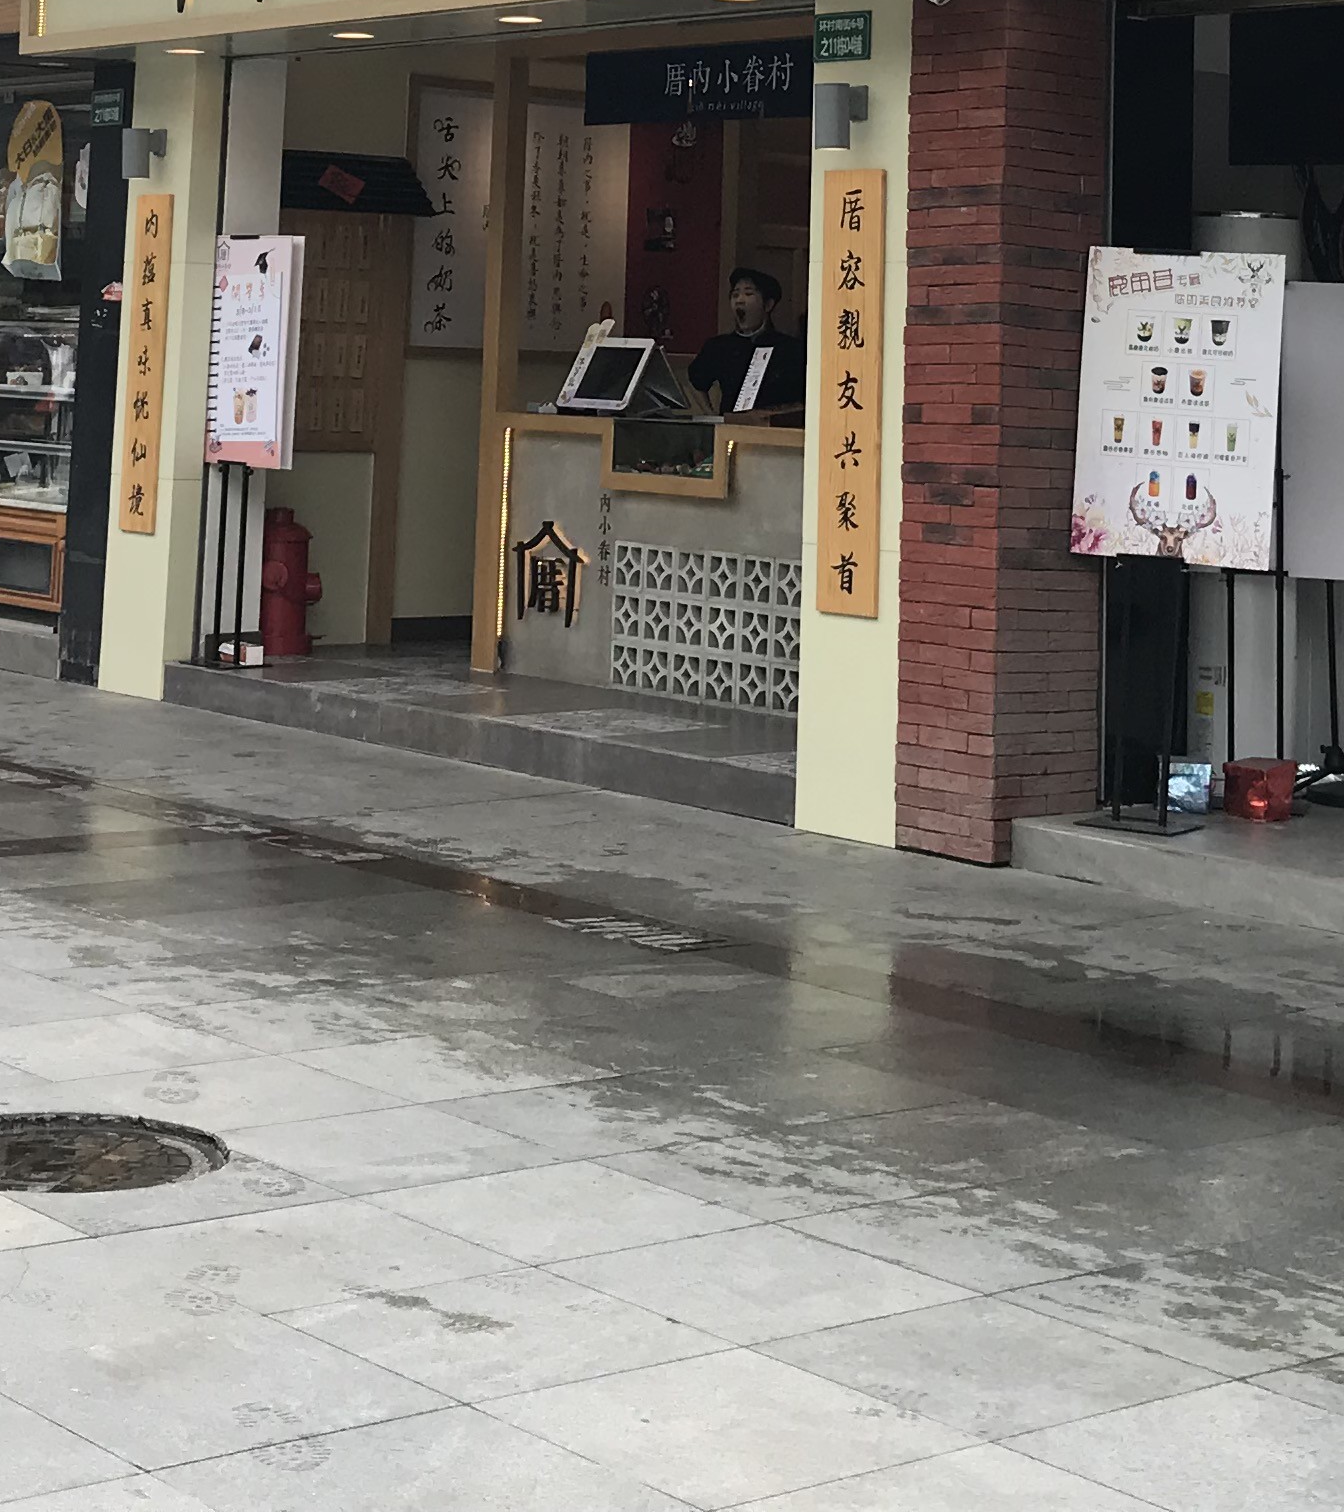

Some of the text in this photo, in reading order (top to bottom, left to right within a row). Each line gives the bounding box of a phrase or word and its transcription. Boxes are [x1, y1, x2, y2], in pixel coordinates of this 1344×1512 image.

[423, 116, 462, 334] 舌尖上的奶茶
